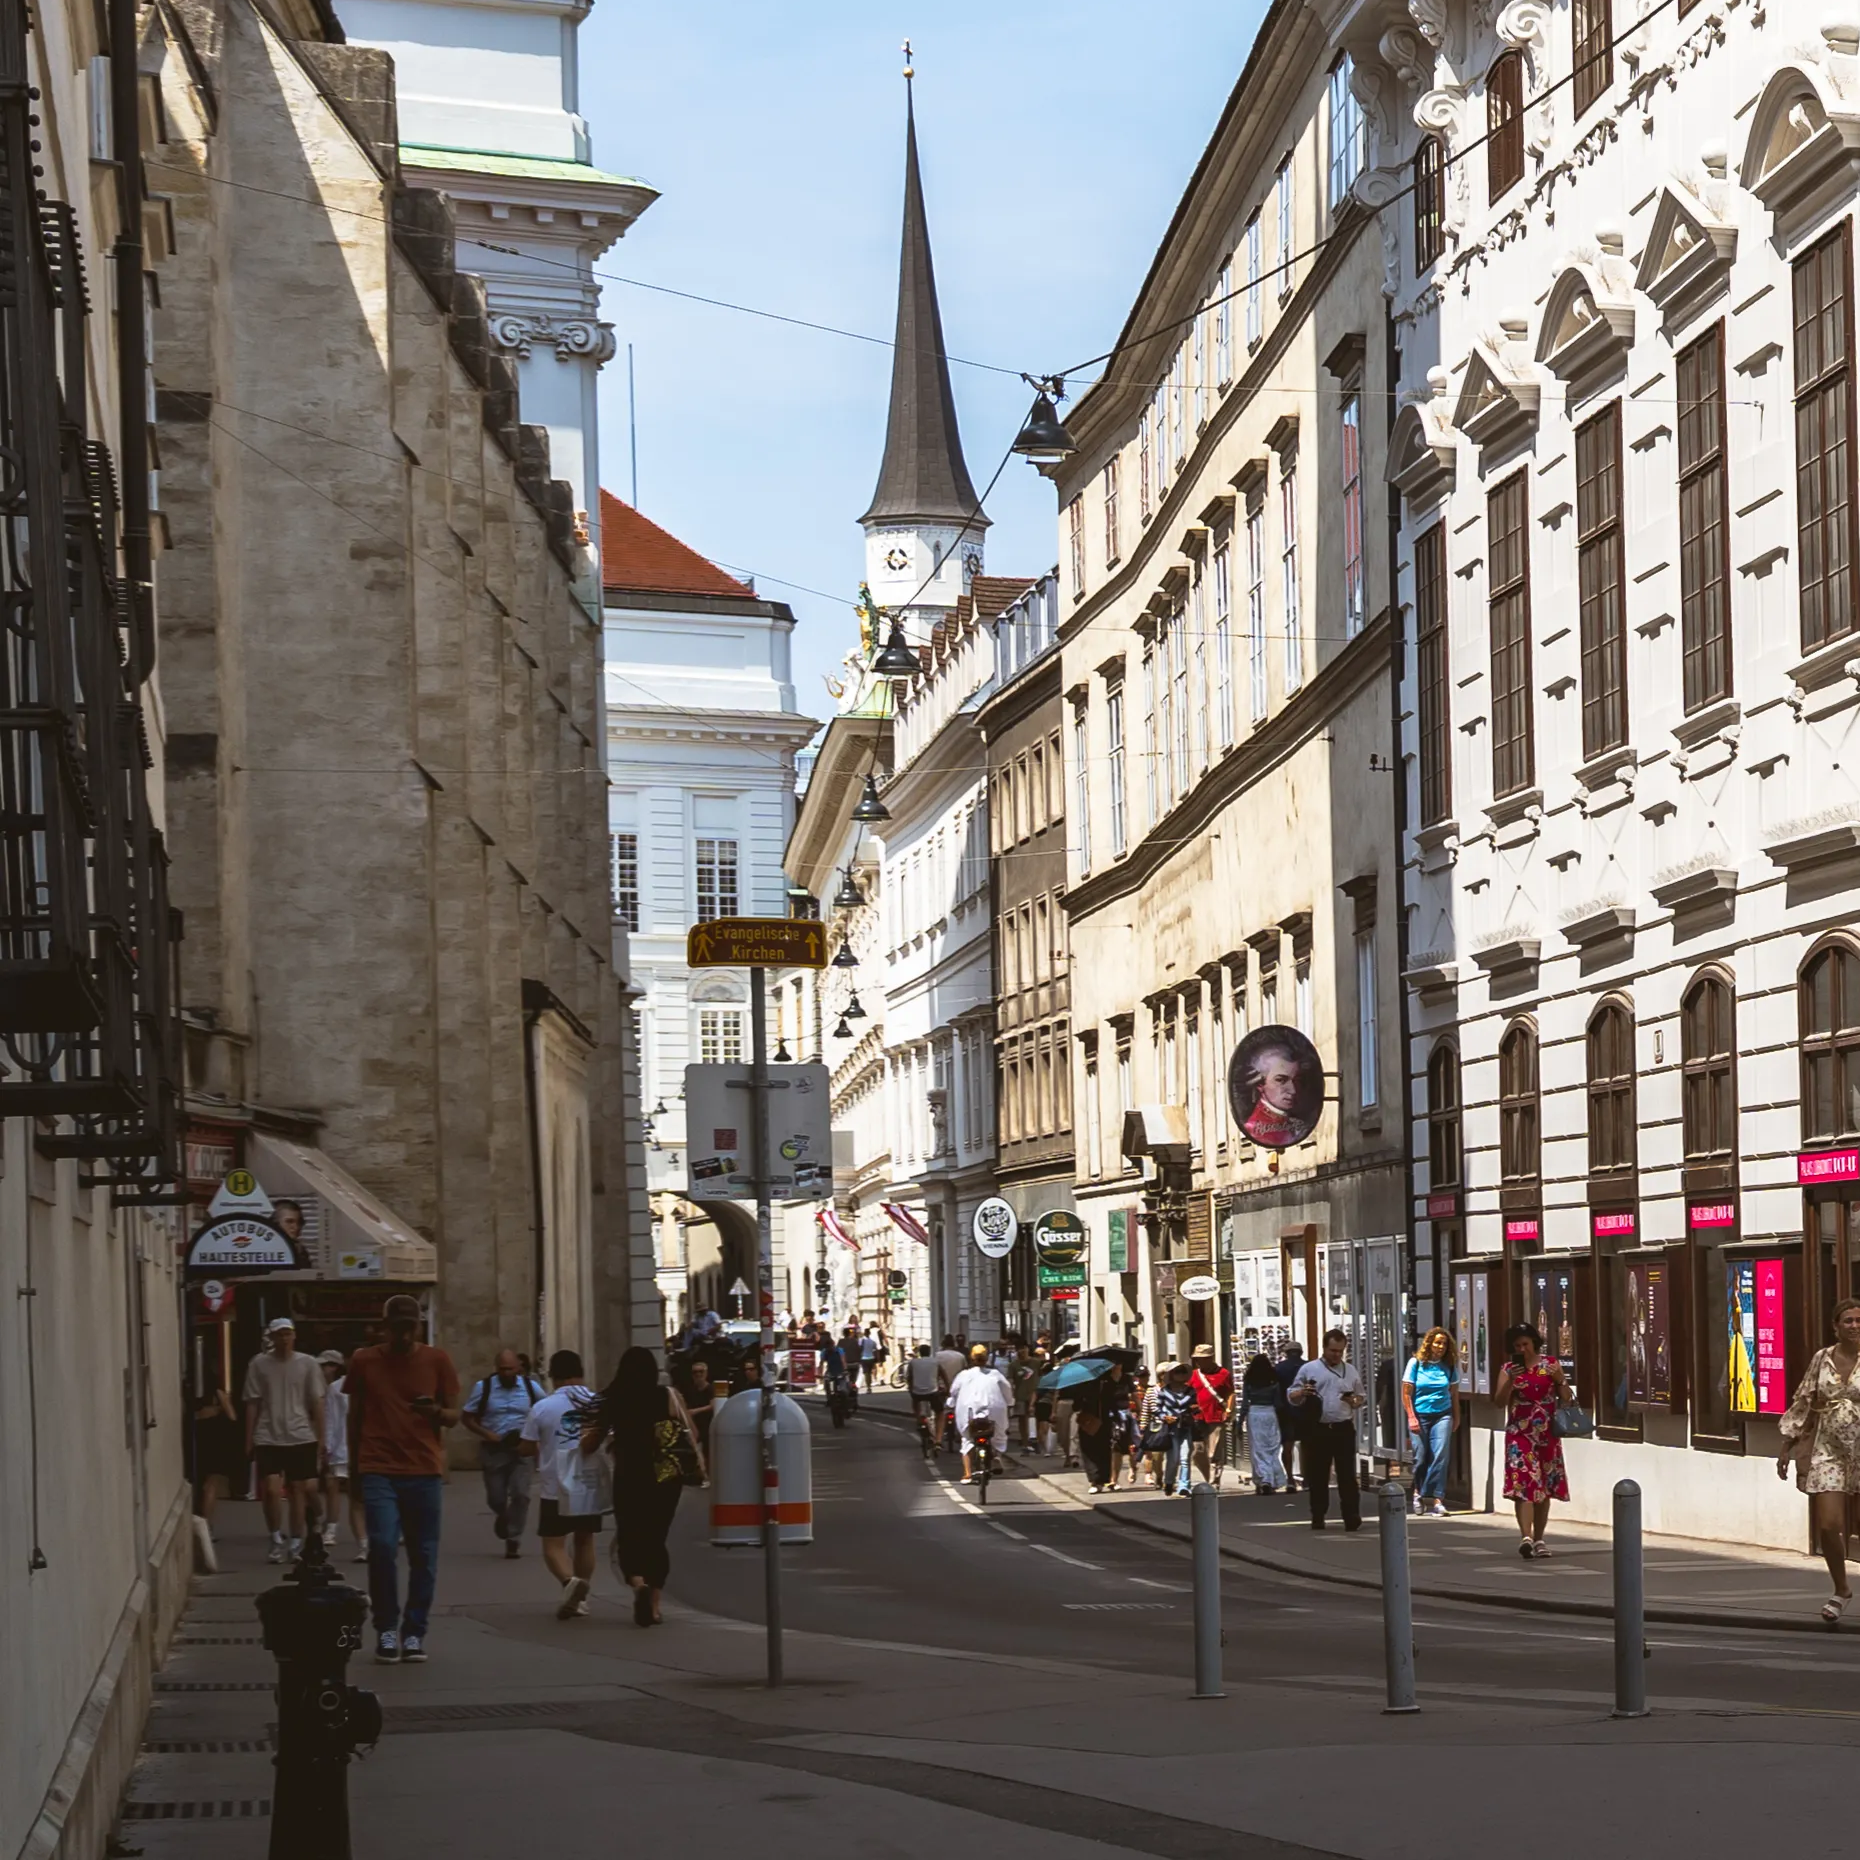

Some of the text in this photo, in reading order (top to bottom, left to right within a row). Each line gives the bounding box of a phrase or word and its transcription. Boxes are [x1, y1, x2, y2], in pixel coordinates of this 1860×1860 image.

[715, 925, 800, 943] Evangelische
[731, 945, 785, 960] Kirchen
[233, 1174, 249, 1192] H
[210, 1223, 275, 1243] AUTOBUS
[1036, 1226, 1083, 1248] Gösser
[198, 1251, 286, 1264] HALTESTELLE
